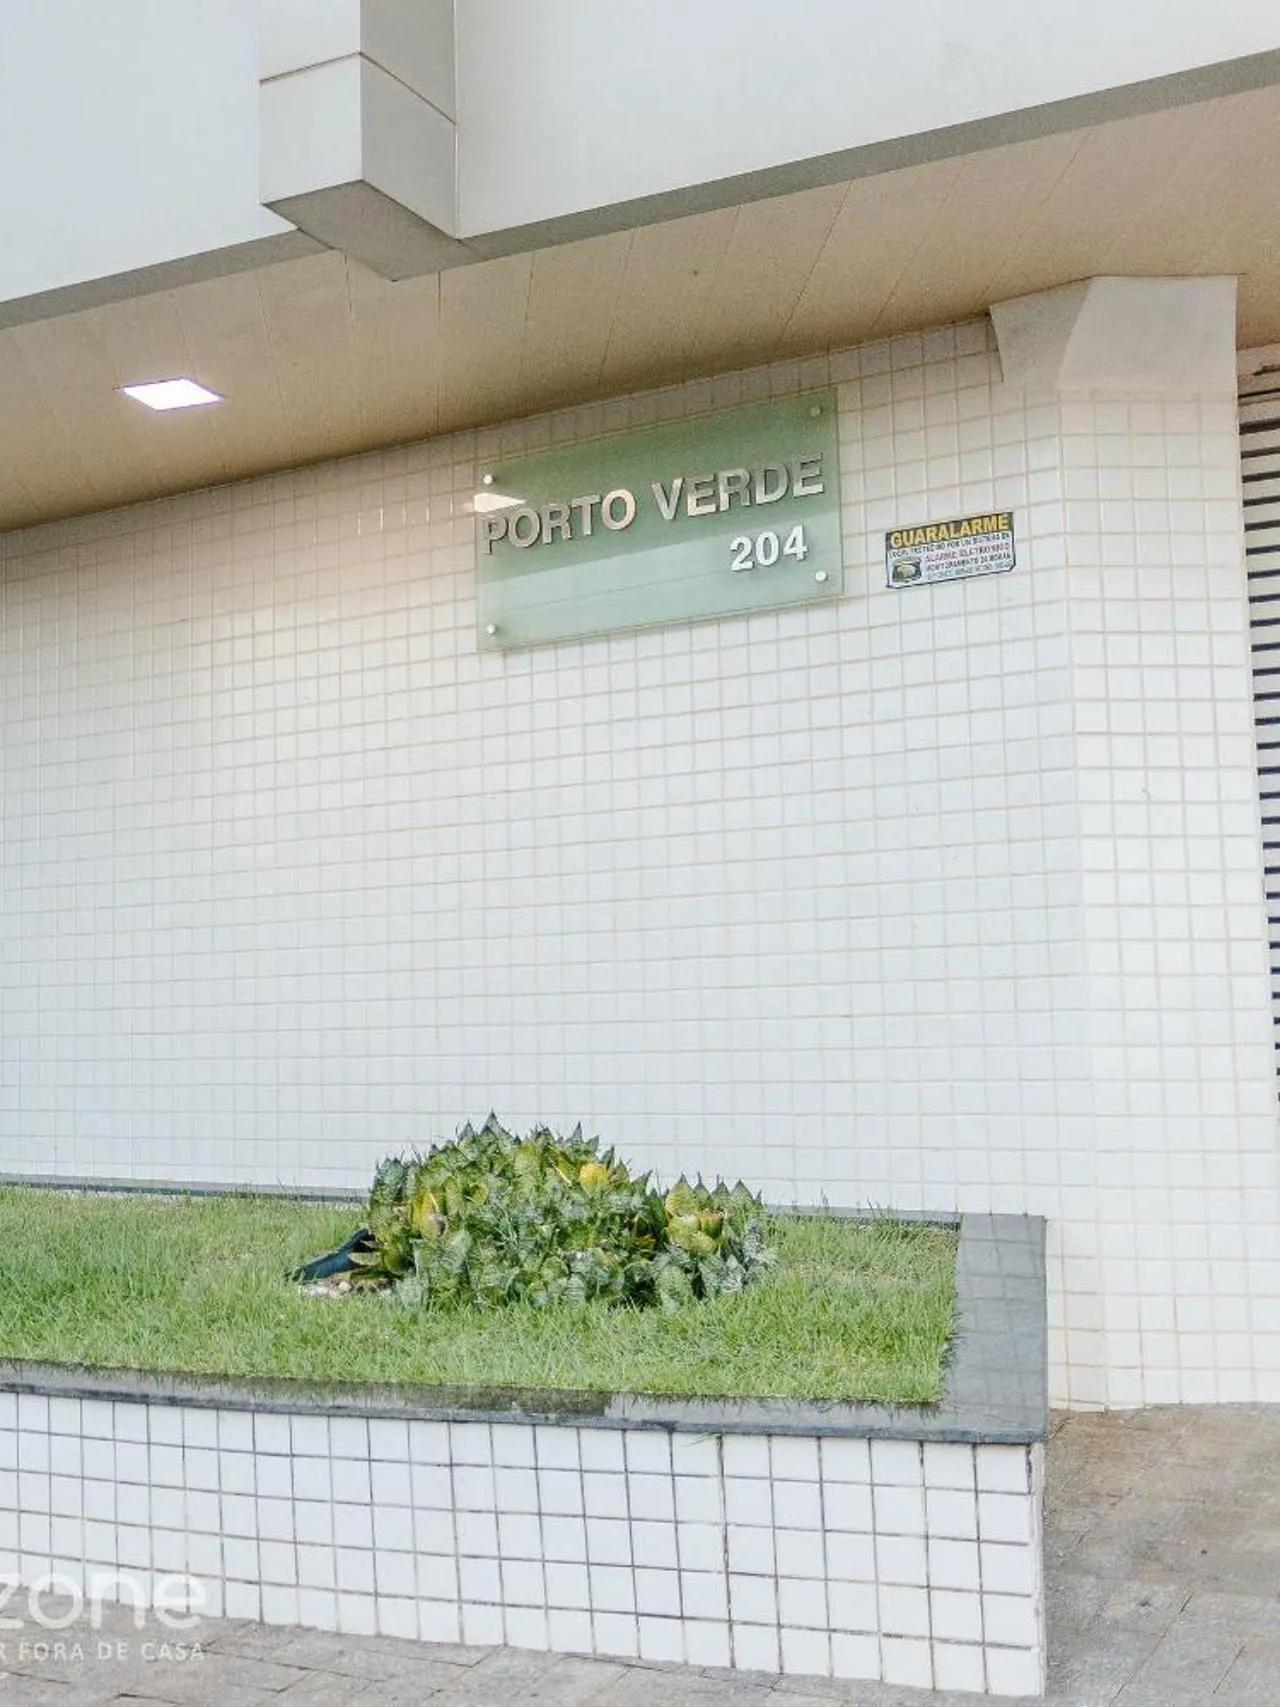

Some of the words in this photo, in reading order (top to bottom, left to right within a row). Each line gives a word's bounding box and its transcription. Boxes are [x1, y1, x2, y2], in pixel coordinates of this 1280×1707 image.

[478, 488, 637, 555] PORTO
[649, 452, 824, 521] VERDE
[729, 520, 808, 571] 204
[890, 513, 1010, 549] GUARALARME
